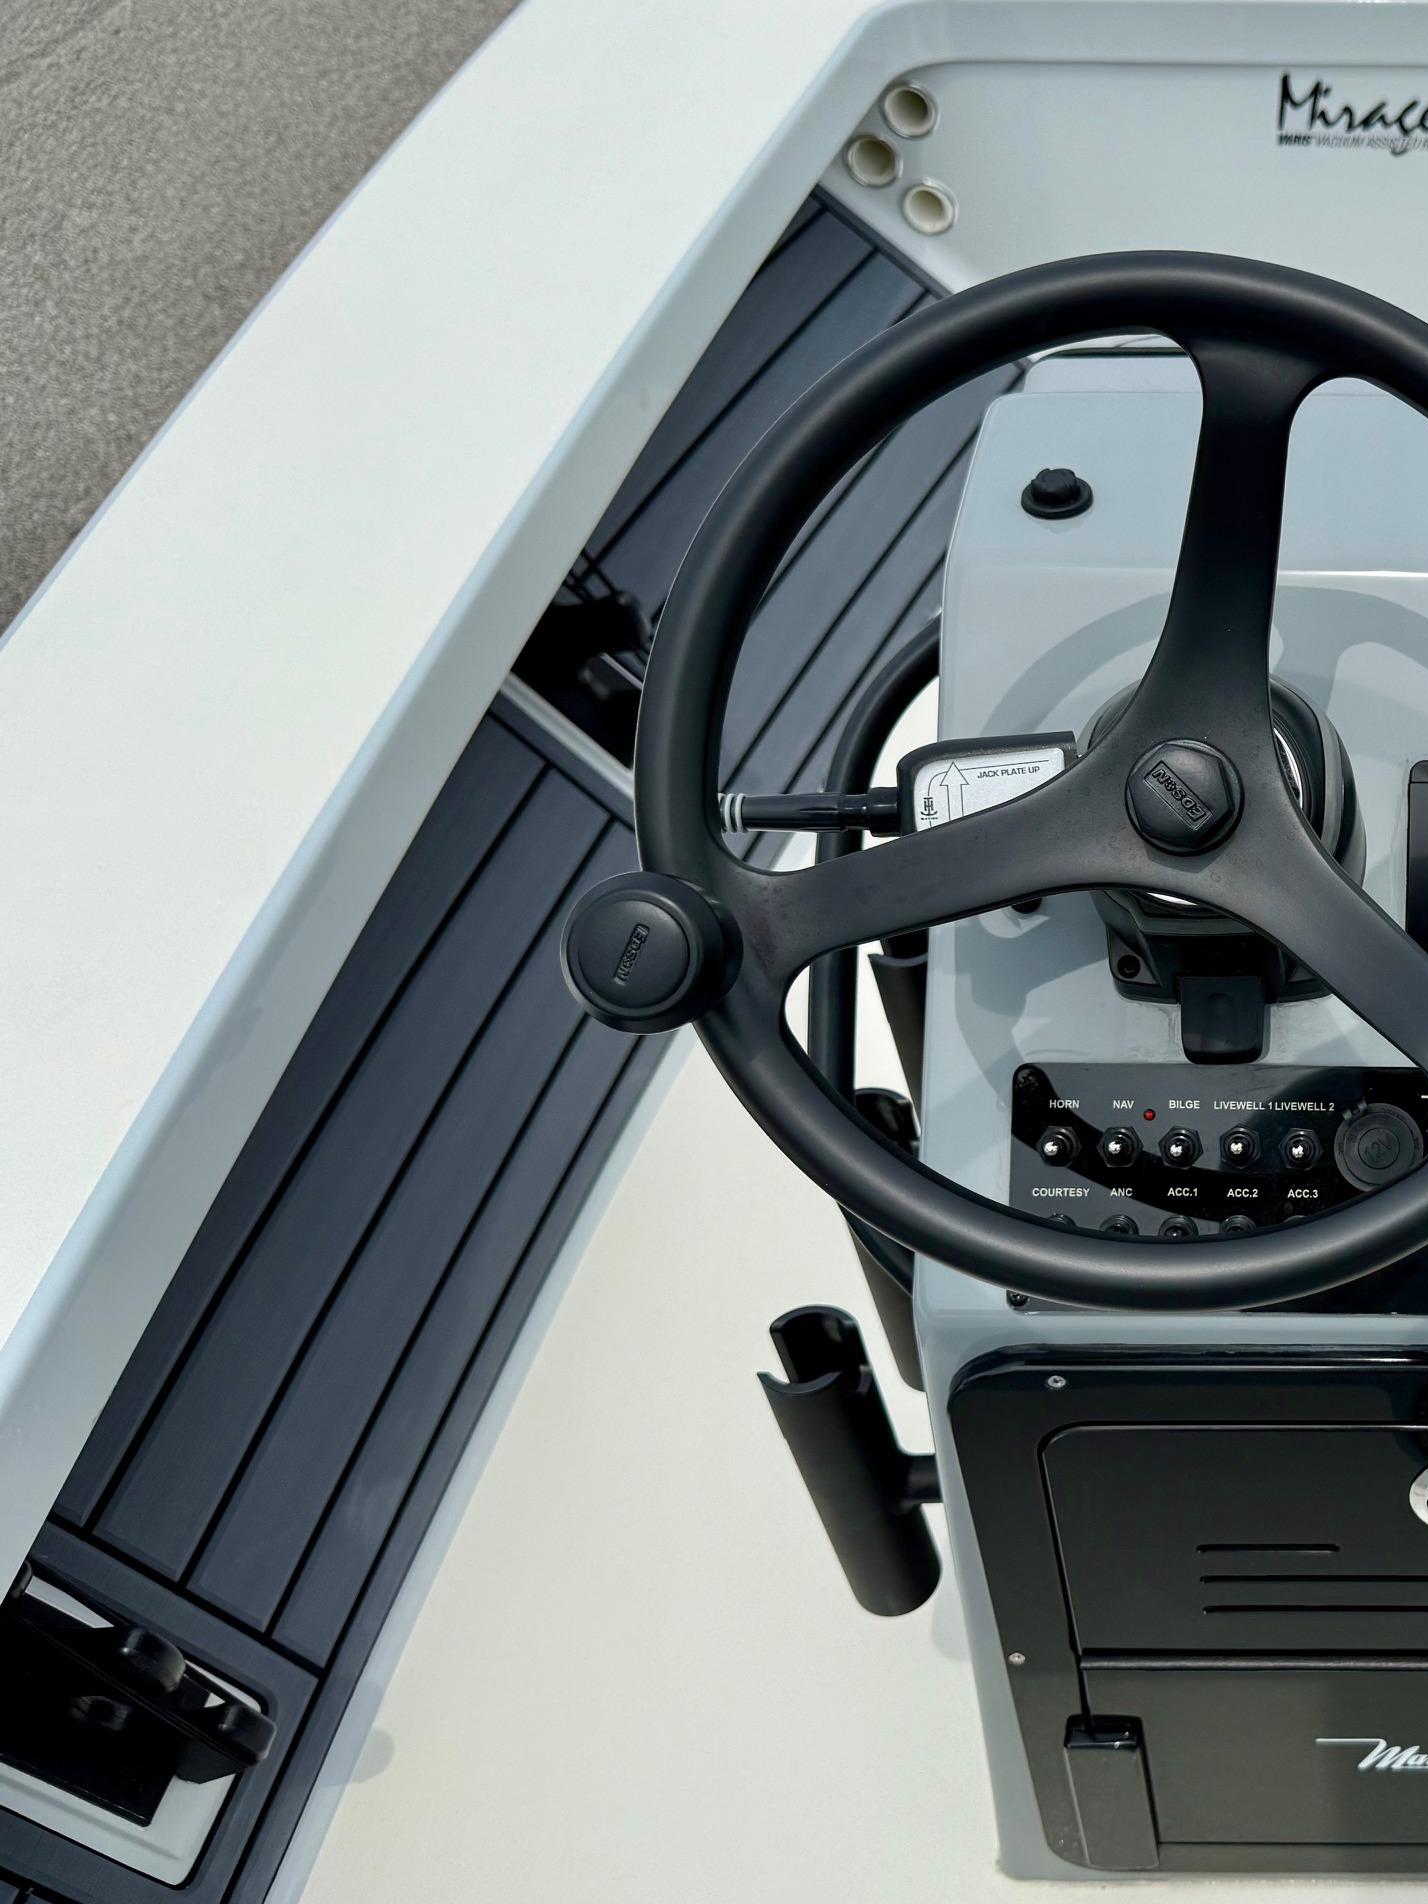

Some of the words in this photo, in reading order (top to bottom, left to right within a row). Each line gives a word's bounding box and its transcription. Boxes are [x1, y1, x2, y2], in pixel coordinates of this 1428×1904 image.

[977, 770, 999, 779] JACK
[1001, 768, 1026, 776] PLATE
[1028, 766, 1040, 774] UP
[1049, 1099, 1080, 1109] HORN
[1113, 1100, 1134, 1109] NAV
[1168, 1100, 1200, 1109] BILGE
[1213, 1101, 1265, 1110] LIVEWELL
[1267, 1102, 1273, 1110] 1
[1274, 1102, 1326, 1111] LIVEWELL
[1328, 1102, 1335, 1111] 2
[1032, 1187, 1090, 1197] COURTESY
[1110, 1187, 1133, 1197] ANC
[1167, 1187, 1198, 1197] ACC.1
[1227, 1188, 1258, 1198] ACC.2
[1287, 1189, 1319, 1199] ACC.3
